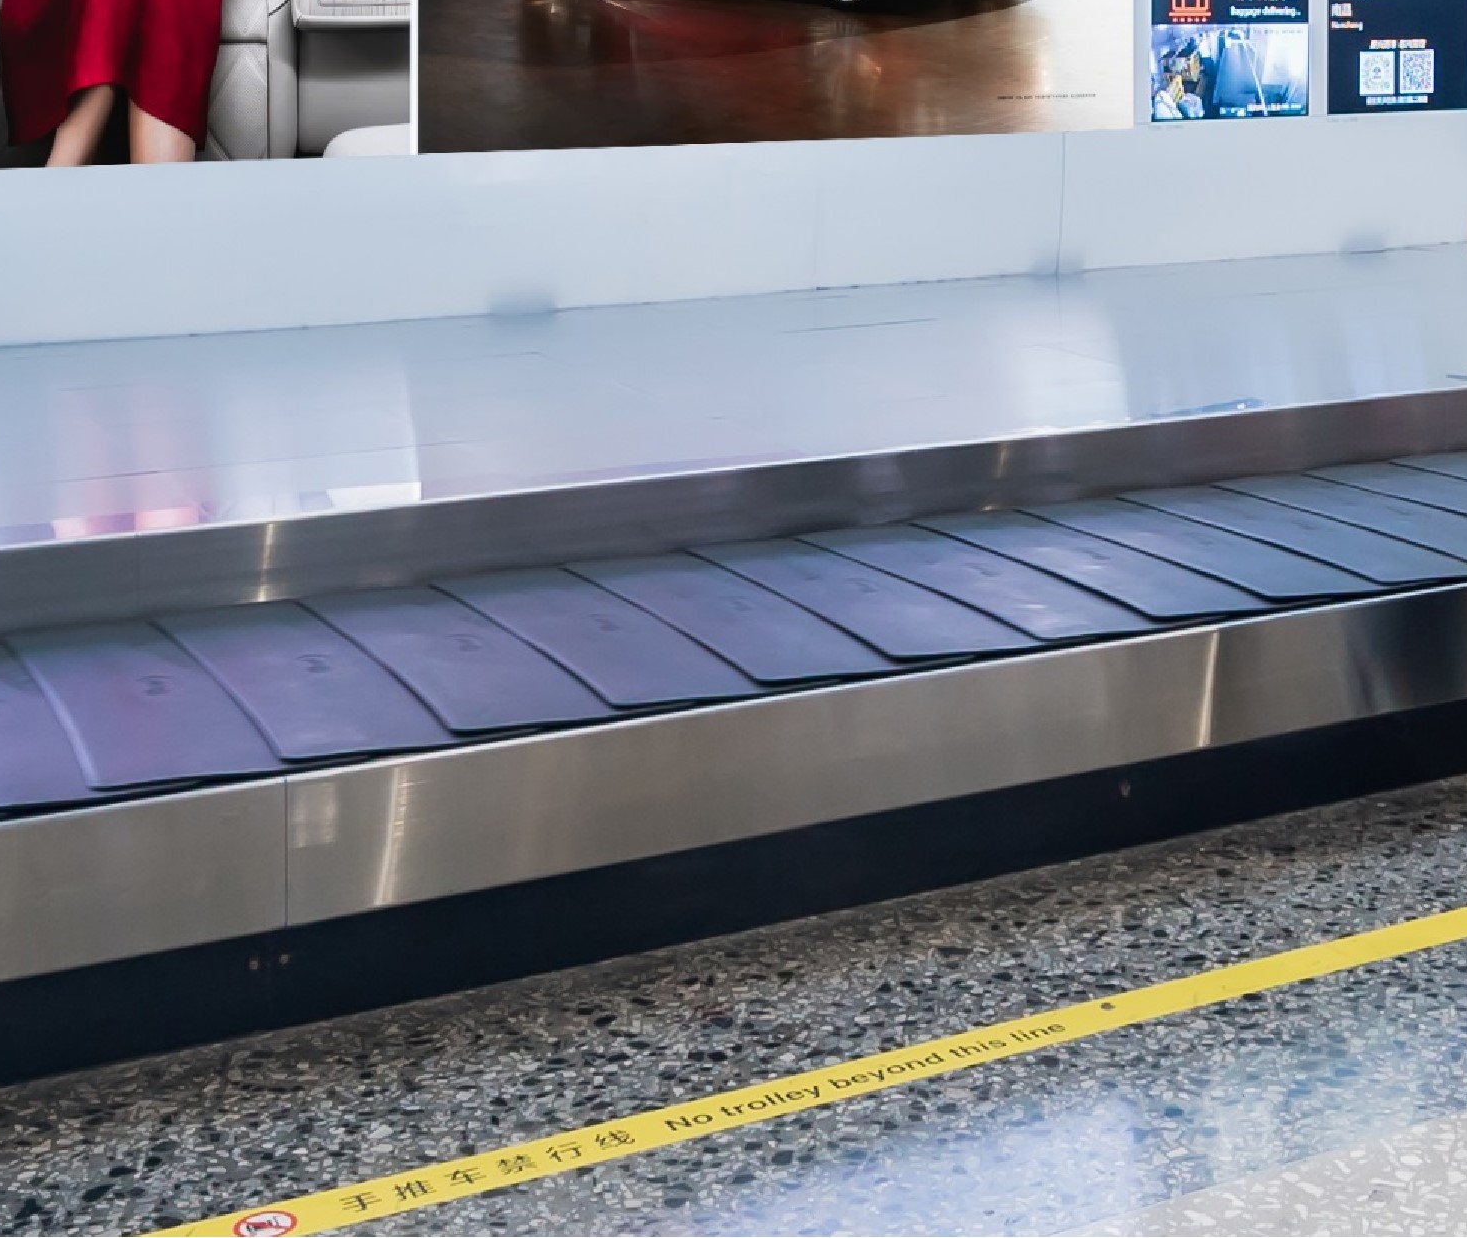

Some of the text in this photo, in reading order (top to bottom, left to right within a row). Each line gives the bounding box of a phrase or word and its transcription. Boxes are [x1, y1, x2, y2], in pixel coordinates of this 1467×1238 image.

[338, 1020, 1067, 1213] 手推车禁行线 No trolley beyond this line
